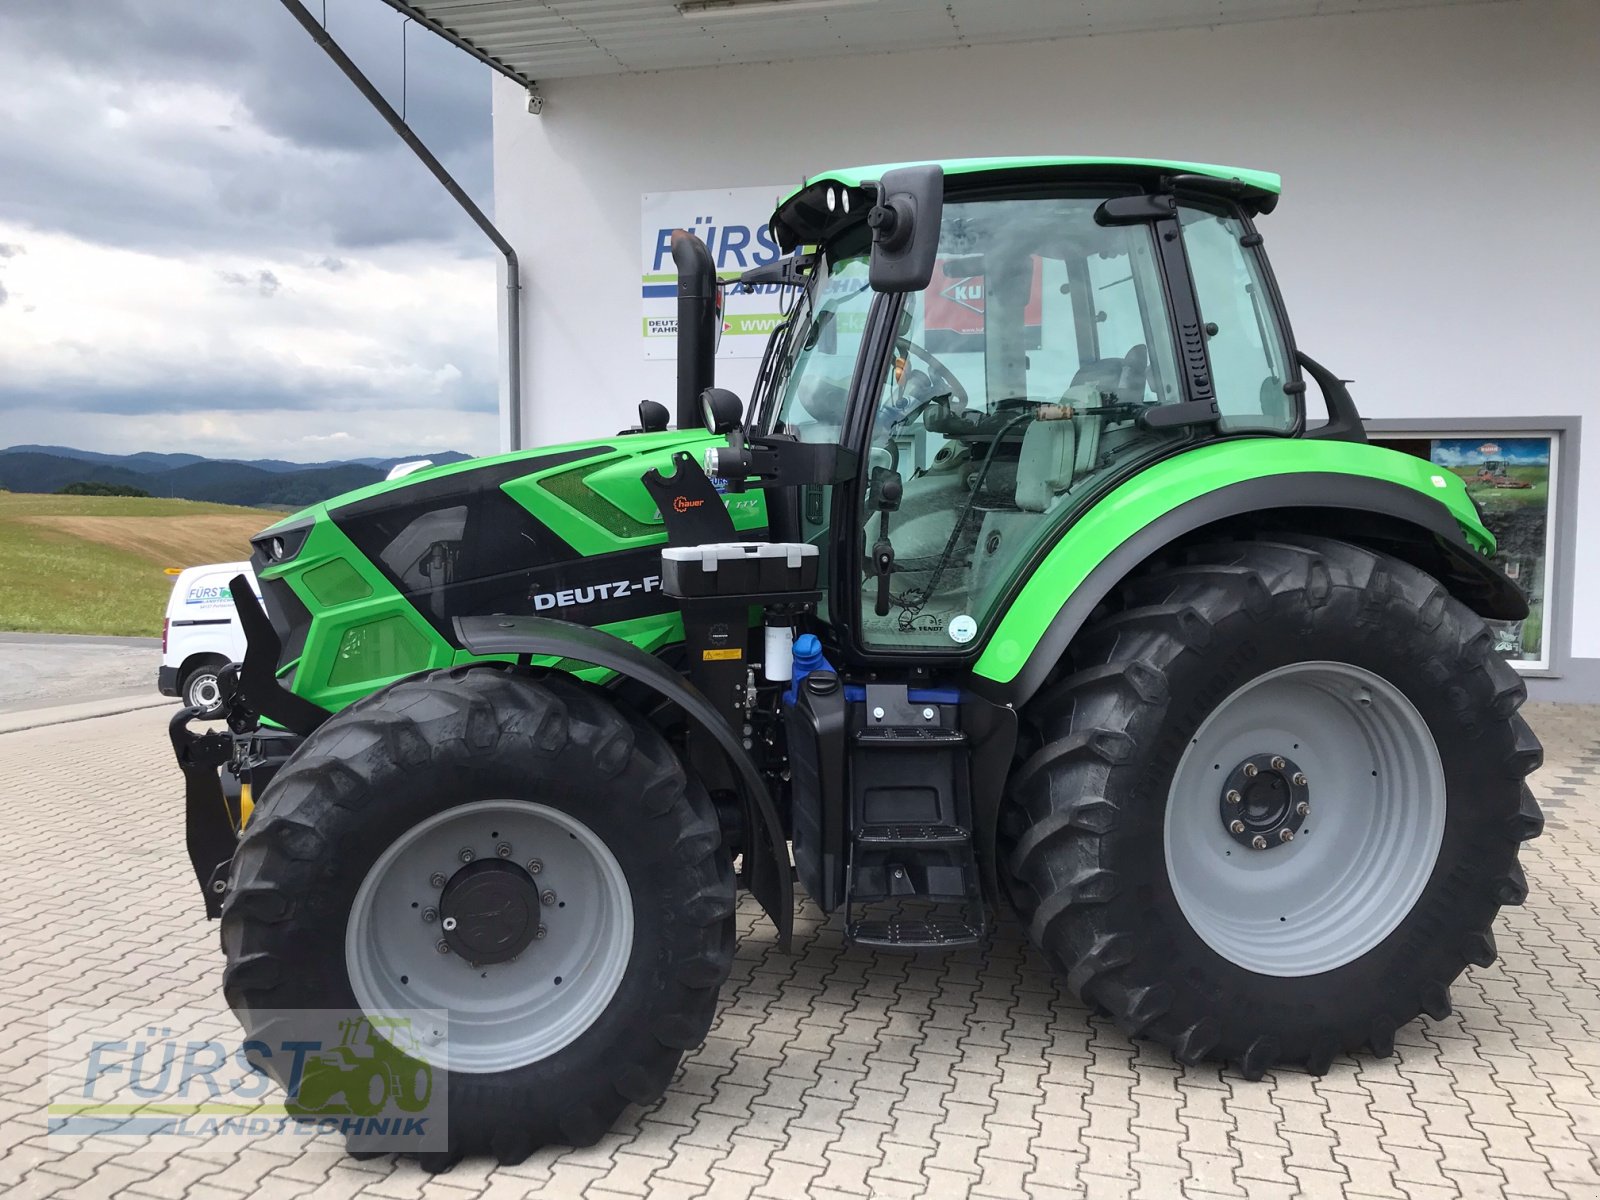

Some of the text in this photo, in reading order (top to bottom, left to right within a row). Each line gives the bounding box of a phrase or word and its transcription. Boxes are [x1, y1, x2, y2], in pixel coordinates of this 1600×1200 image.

[653, 216, 803, 271] FÜRS
[954, 285, 984, 300] KU
[678, 499, 704, 508] hauer
[533, 575, 663, 611] DEUTZ-F
